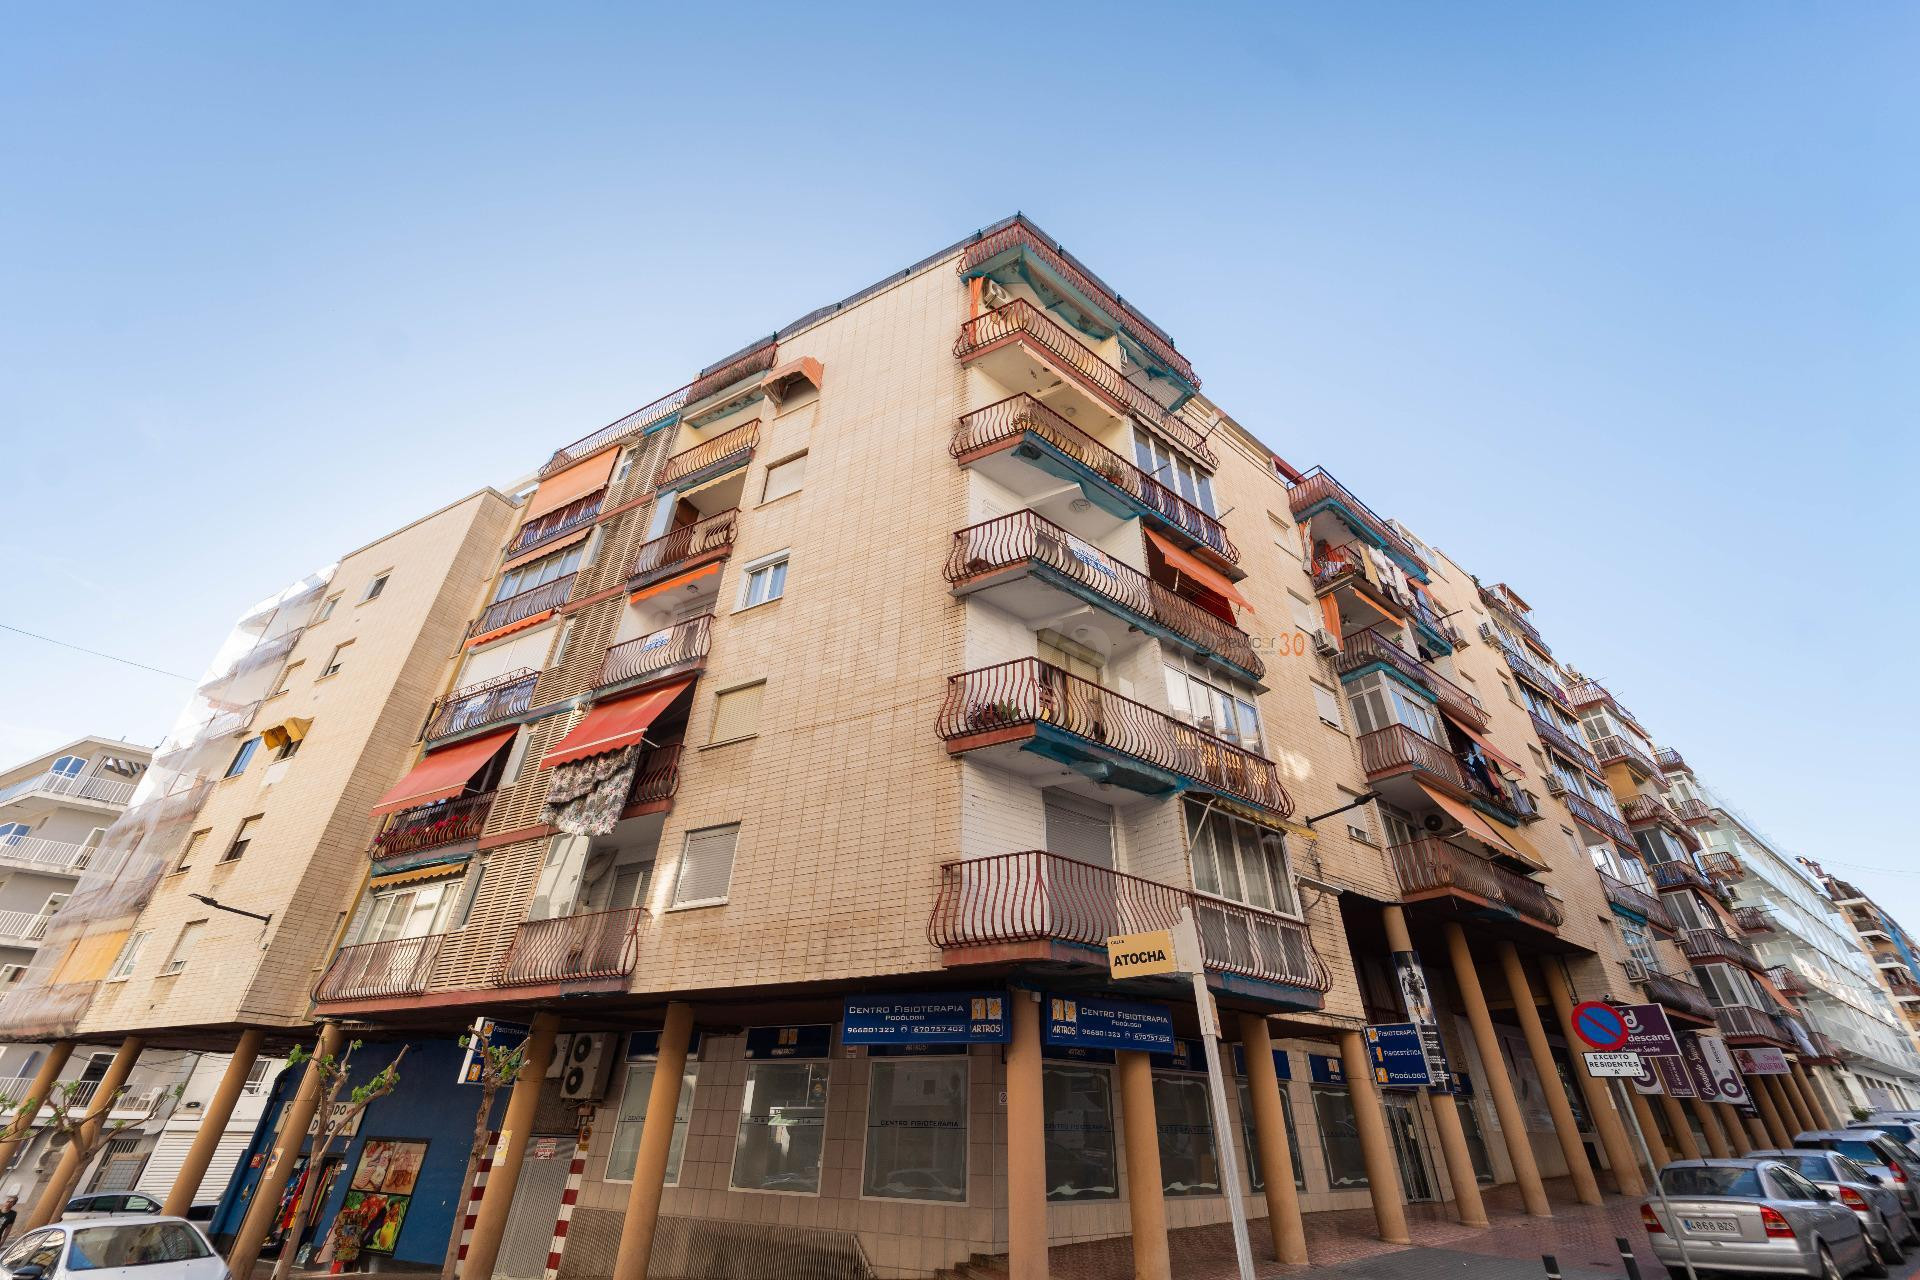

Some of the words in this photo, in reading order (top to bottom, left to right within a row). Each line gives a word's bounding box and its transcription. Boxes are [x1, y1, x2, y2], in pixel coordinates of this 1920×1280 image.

[1113, 949, 1167, 967] ATOCHA
[849, 1006, 890, 1014] CENTRO
[894, 1005, 965, 1013] FISIOTERAPIA
[1081, 1007, 1115, 1018] CENTRO
[1117, 1011, 1169, 1024] FISIOTERAPIA
[971, 1024, 1001, 1033] ARTROS
[1052, 1025, 1076, 1036] ARTROS
[1627, 1034, 1671, 1042] descans
